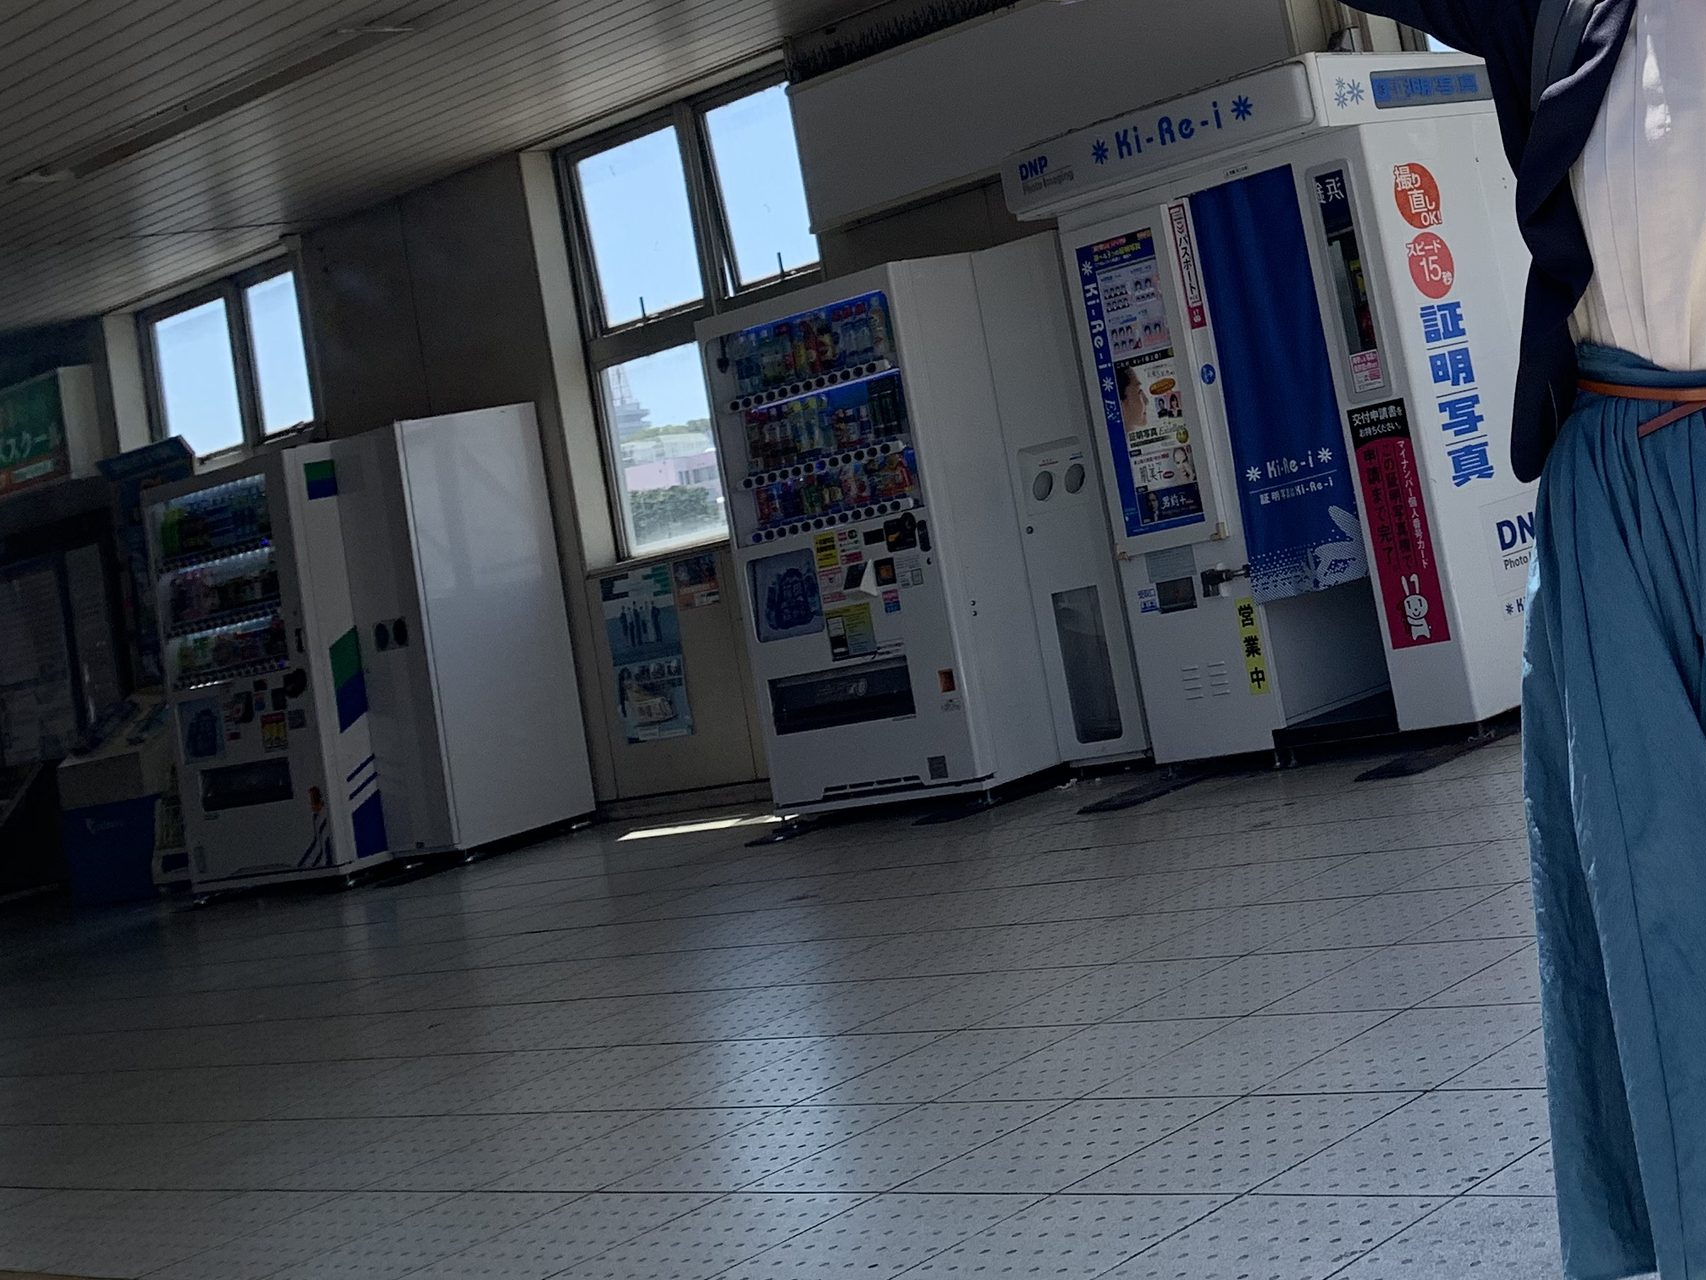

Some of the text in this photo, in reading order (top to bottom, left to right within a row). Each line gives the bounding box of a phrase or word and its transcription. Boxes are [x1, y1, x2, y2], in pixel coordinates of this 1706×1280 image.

[1115, 101, 1222, 159] Ki-Re-i
[1018, 155, 1048, 181] DNP
[1393, 165, 1421, 190] 撮り
[1407, 188, 1436, 214] 直し
[1420, 210, 1443, 226] OK!
[1406, 240, 1441, 258] スピード
[1083, 282, 1112, 370] Ki-Re-i
[1420, 301, 1495, 487] 証明写真
[1352, 405, 1403, 427] 交付申請書を
[1503, 554, 1528, 570] Photo
[1238, 603, 1265, 689] 営業中
